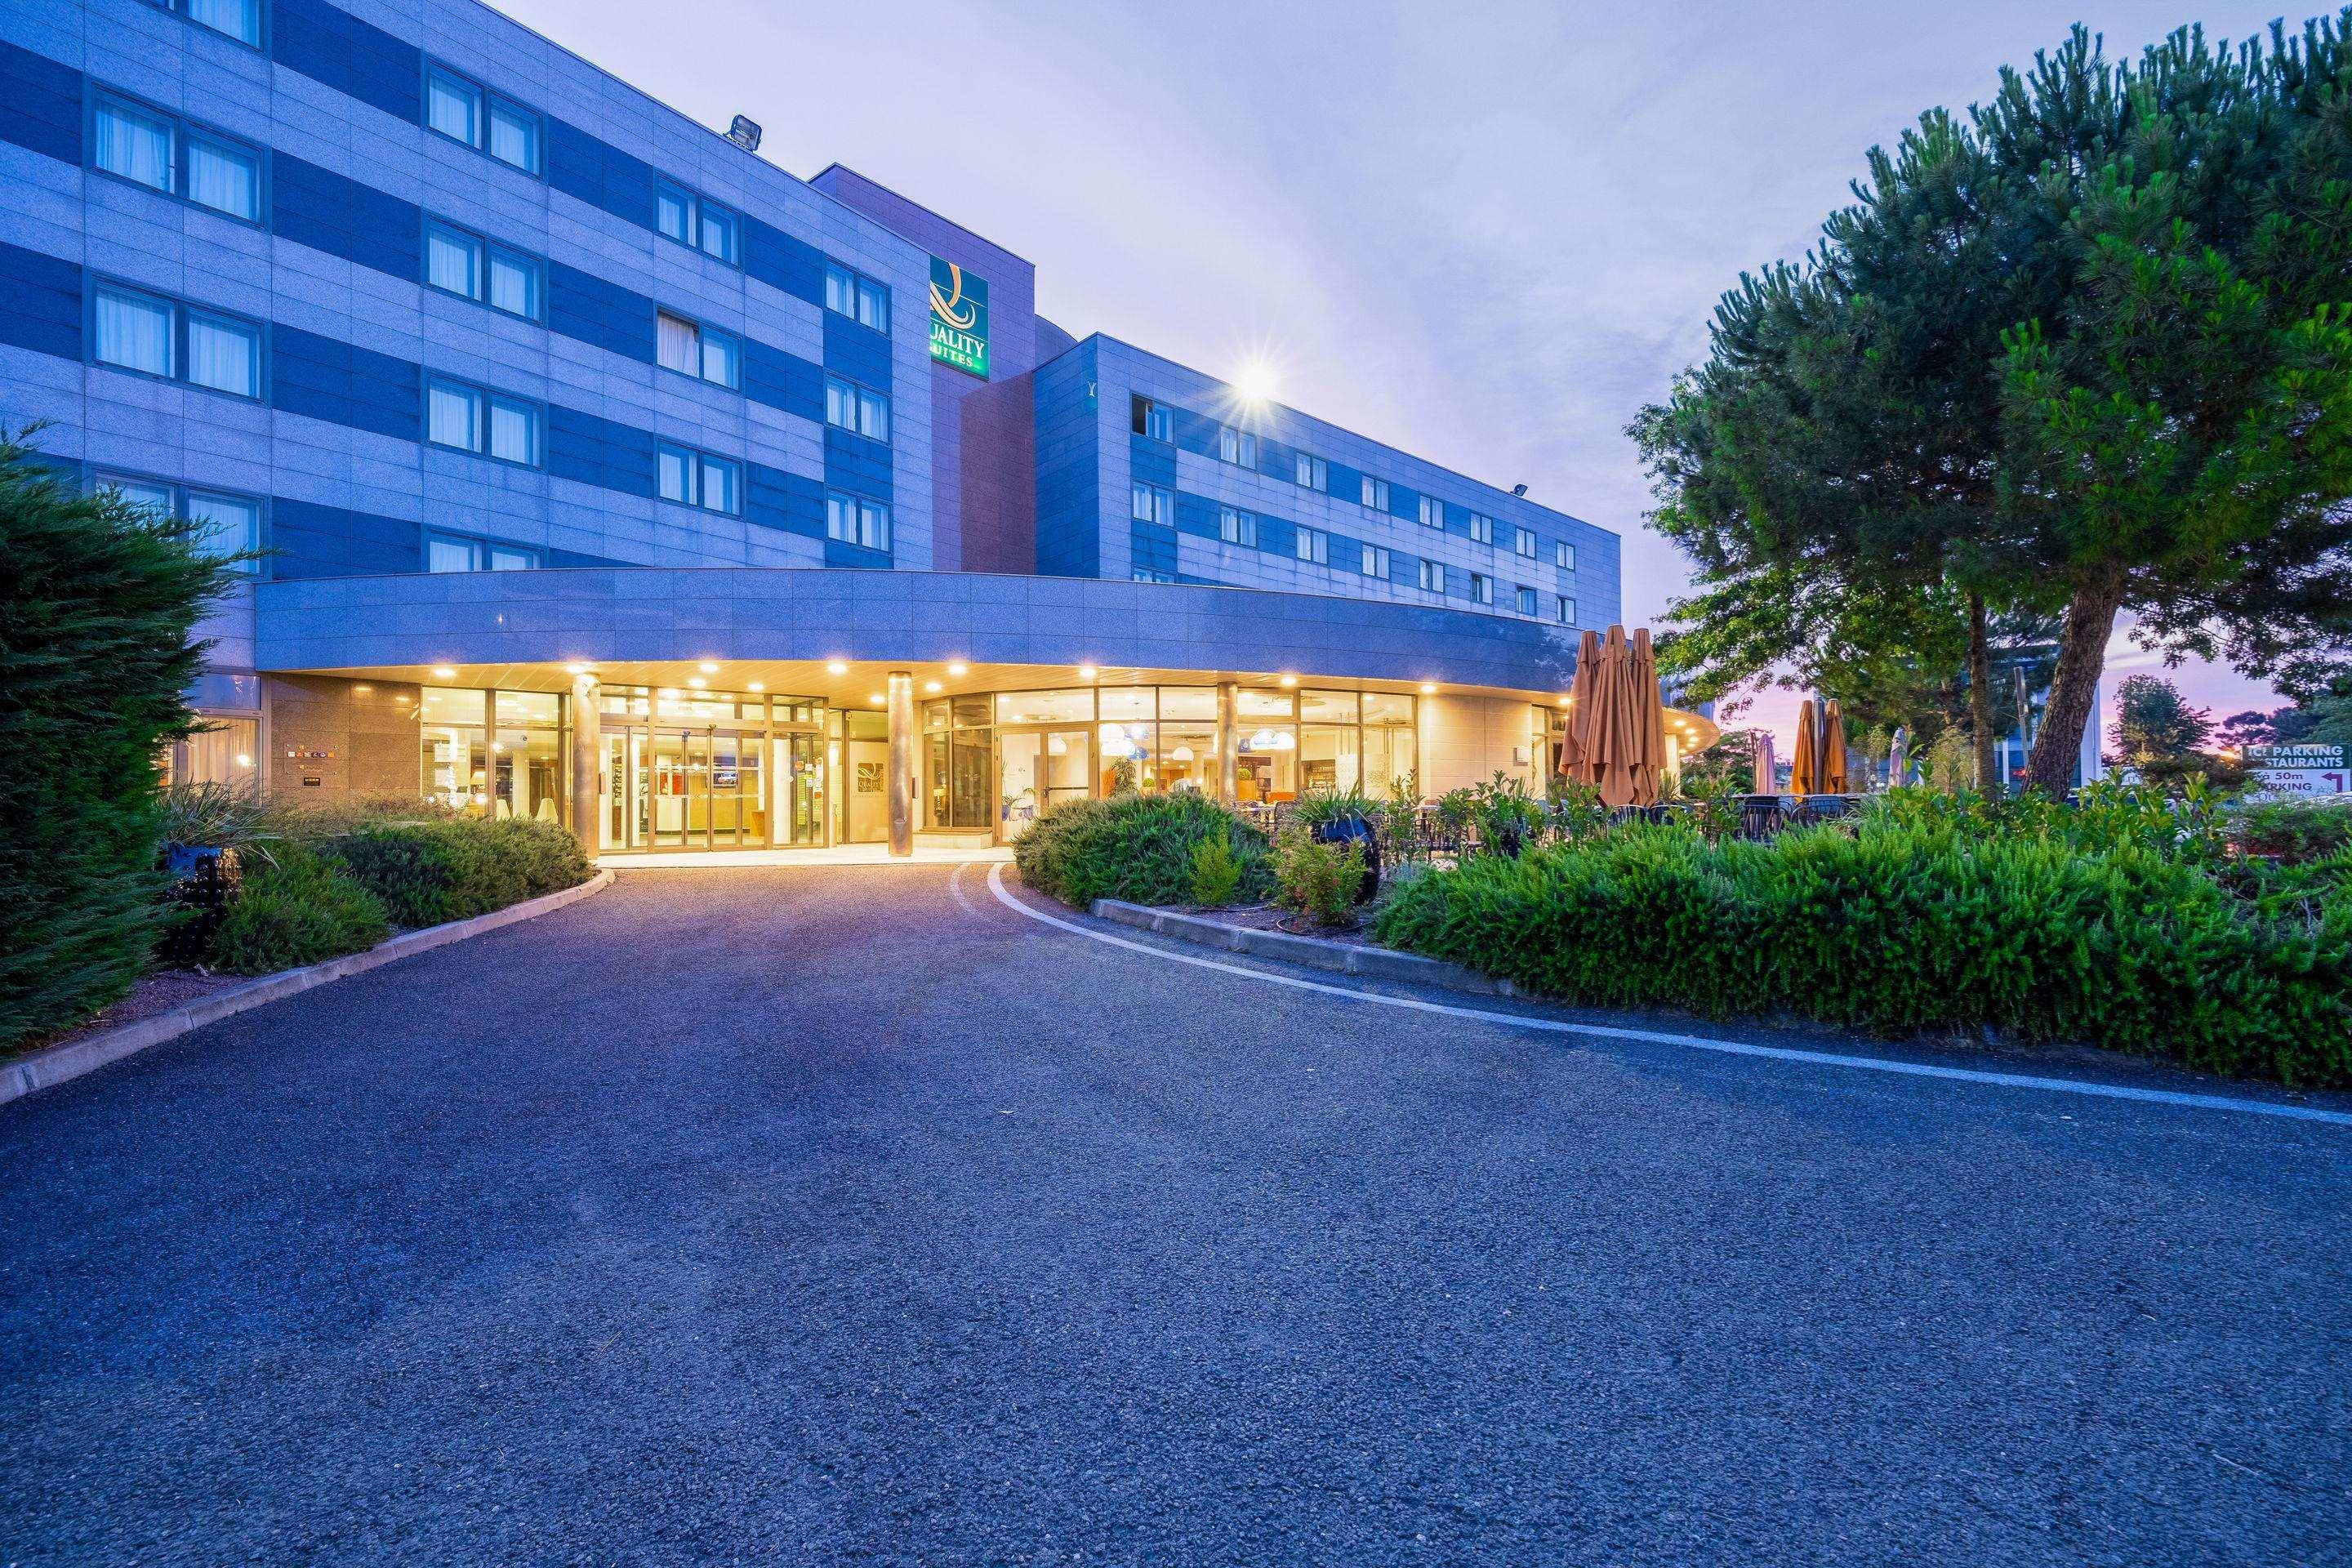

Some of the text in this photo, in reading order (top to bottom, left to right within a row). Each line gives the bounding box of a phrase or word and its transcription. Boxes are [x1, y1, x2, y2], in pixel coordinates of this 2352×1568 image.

[929, 322, 985, 359] UALITY
[929, 345, 973, 367] UITES
[2273, 746, 2343, 756] PARKING
[2265, 757, 2343, 768] STAURANTS
[2266, 782, 2312, 791] RKING
